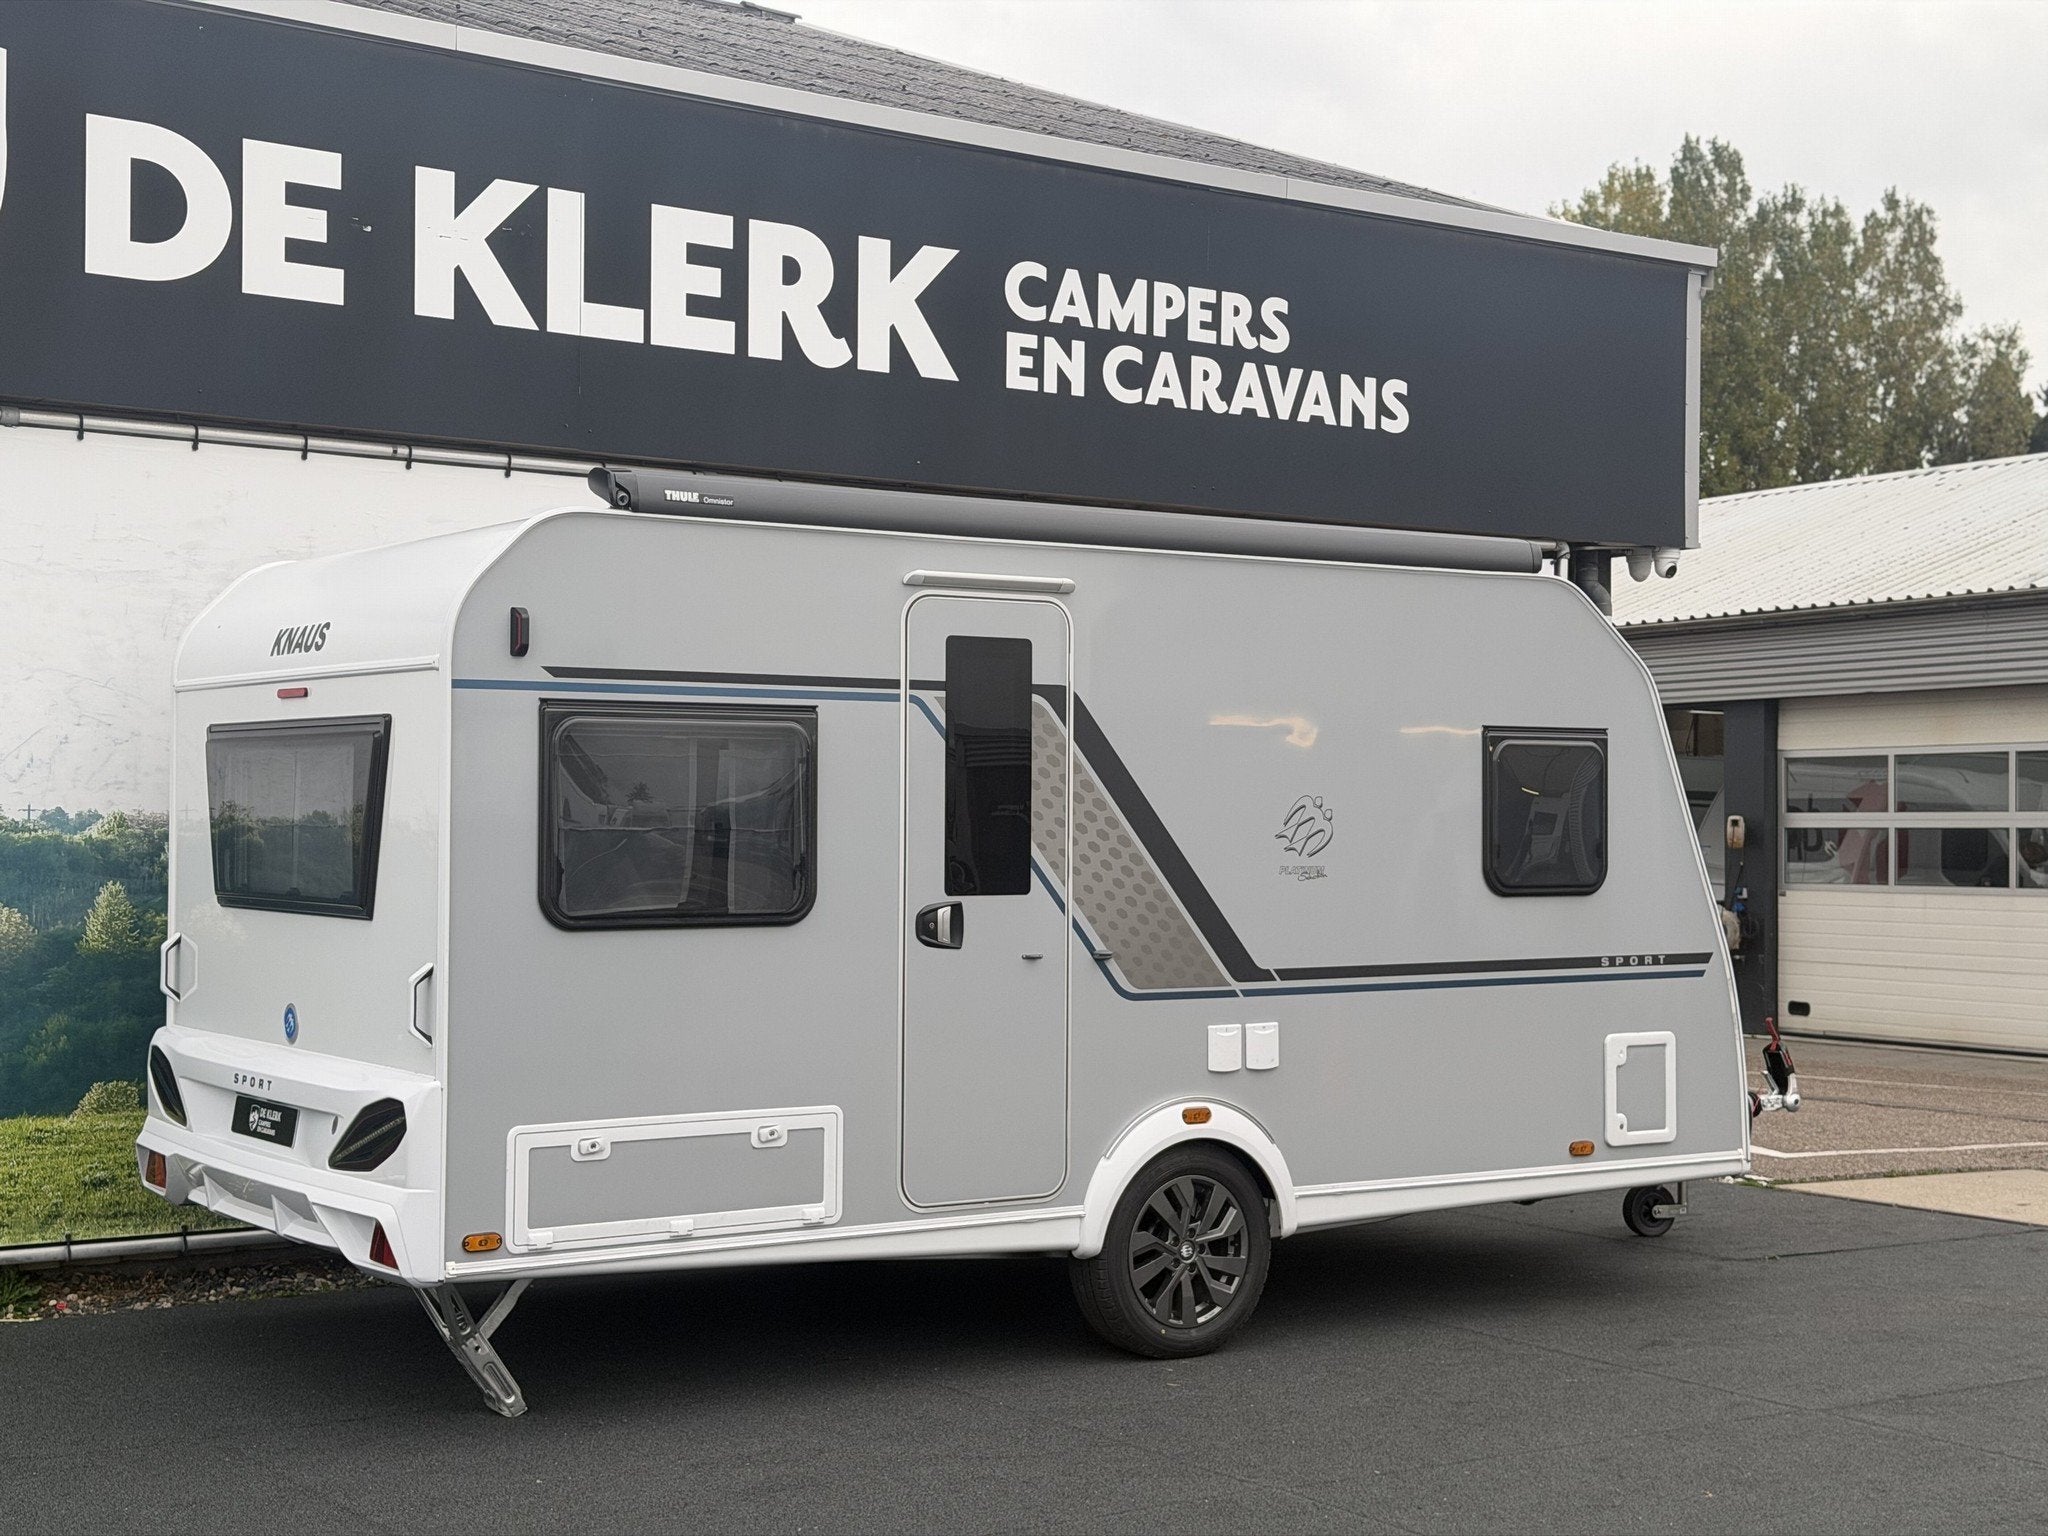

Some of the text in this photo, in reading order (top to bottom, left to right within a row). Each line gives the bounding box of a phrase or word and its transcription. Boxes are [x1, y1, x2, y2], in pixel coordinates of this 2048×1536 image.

[85, 113, 960, 382] DE KLERK
[1004, 261, 1290, 354] CAMPERS
[1005, 331, 1410, 434] EN CARAVANS
[664, 489, 734, 506] THULE Omnistor
[270, 621, 331, 657] KNAUS
[1600, 955, 1666, 967] SPORT
[233, 1073, 272, 1091] SPORT
